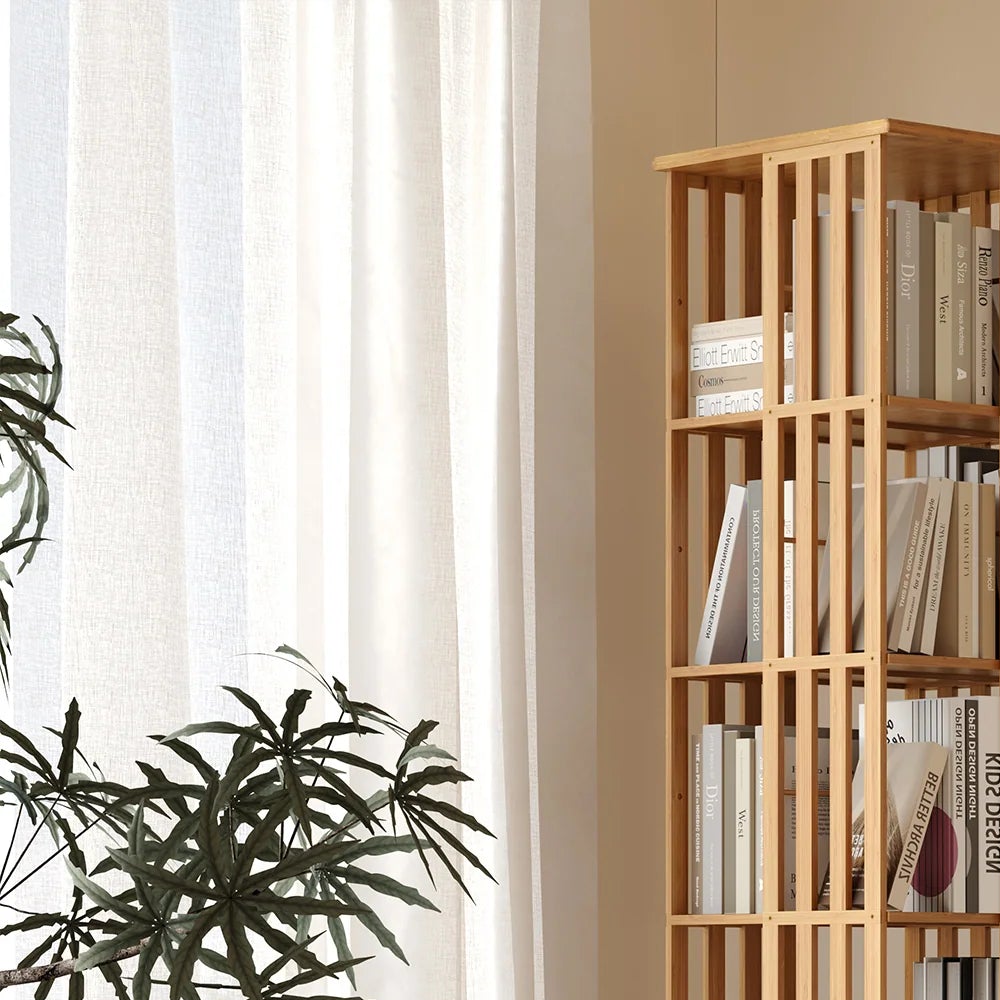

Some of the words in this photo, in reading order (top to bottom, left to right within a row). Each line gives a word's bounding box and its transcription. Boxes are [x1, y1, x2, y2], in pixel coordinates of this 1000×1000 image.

[957, 262, 968, 284] Siza
[978, 246, 992, 276] Renzo
[901, 261, 915, 299] Dior
[978, 278, 992, 306] Piano
[939, 295, 949, 323] West
[693, 346, 718, 368] Elliott
[721, 343, 748, 364] Erwitt
[698, 375, 725, 389] Cosmos
[698, 397, 722, 417] Elliott
[725, 394, 750, 415] Erwitt
[963, 504, 969, 517] ON
[906, 547, 916, 572] GOOD
[912, 520, 920, 546] GUIDE
[919, 529, 930, 569] sustainable
[926, 498, 936, 527] lifestyle
[986, 557, 995, 592] spherical
[929, 580, 939, 612] DREAM
[706, 784, 718, 820] Dior
[738, 809, 747, 838] West
